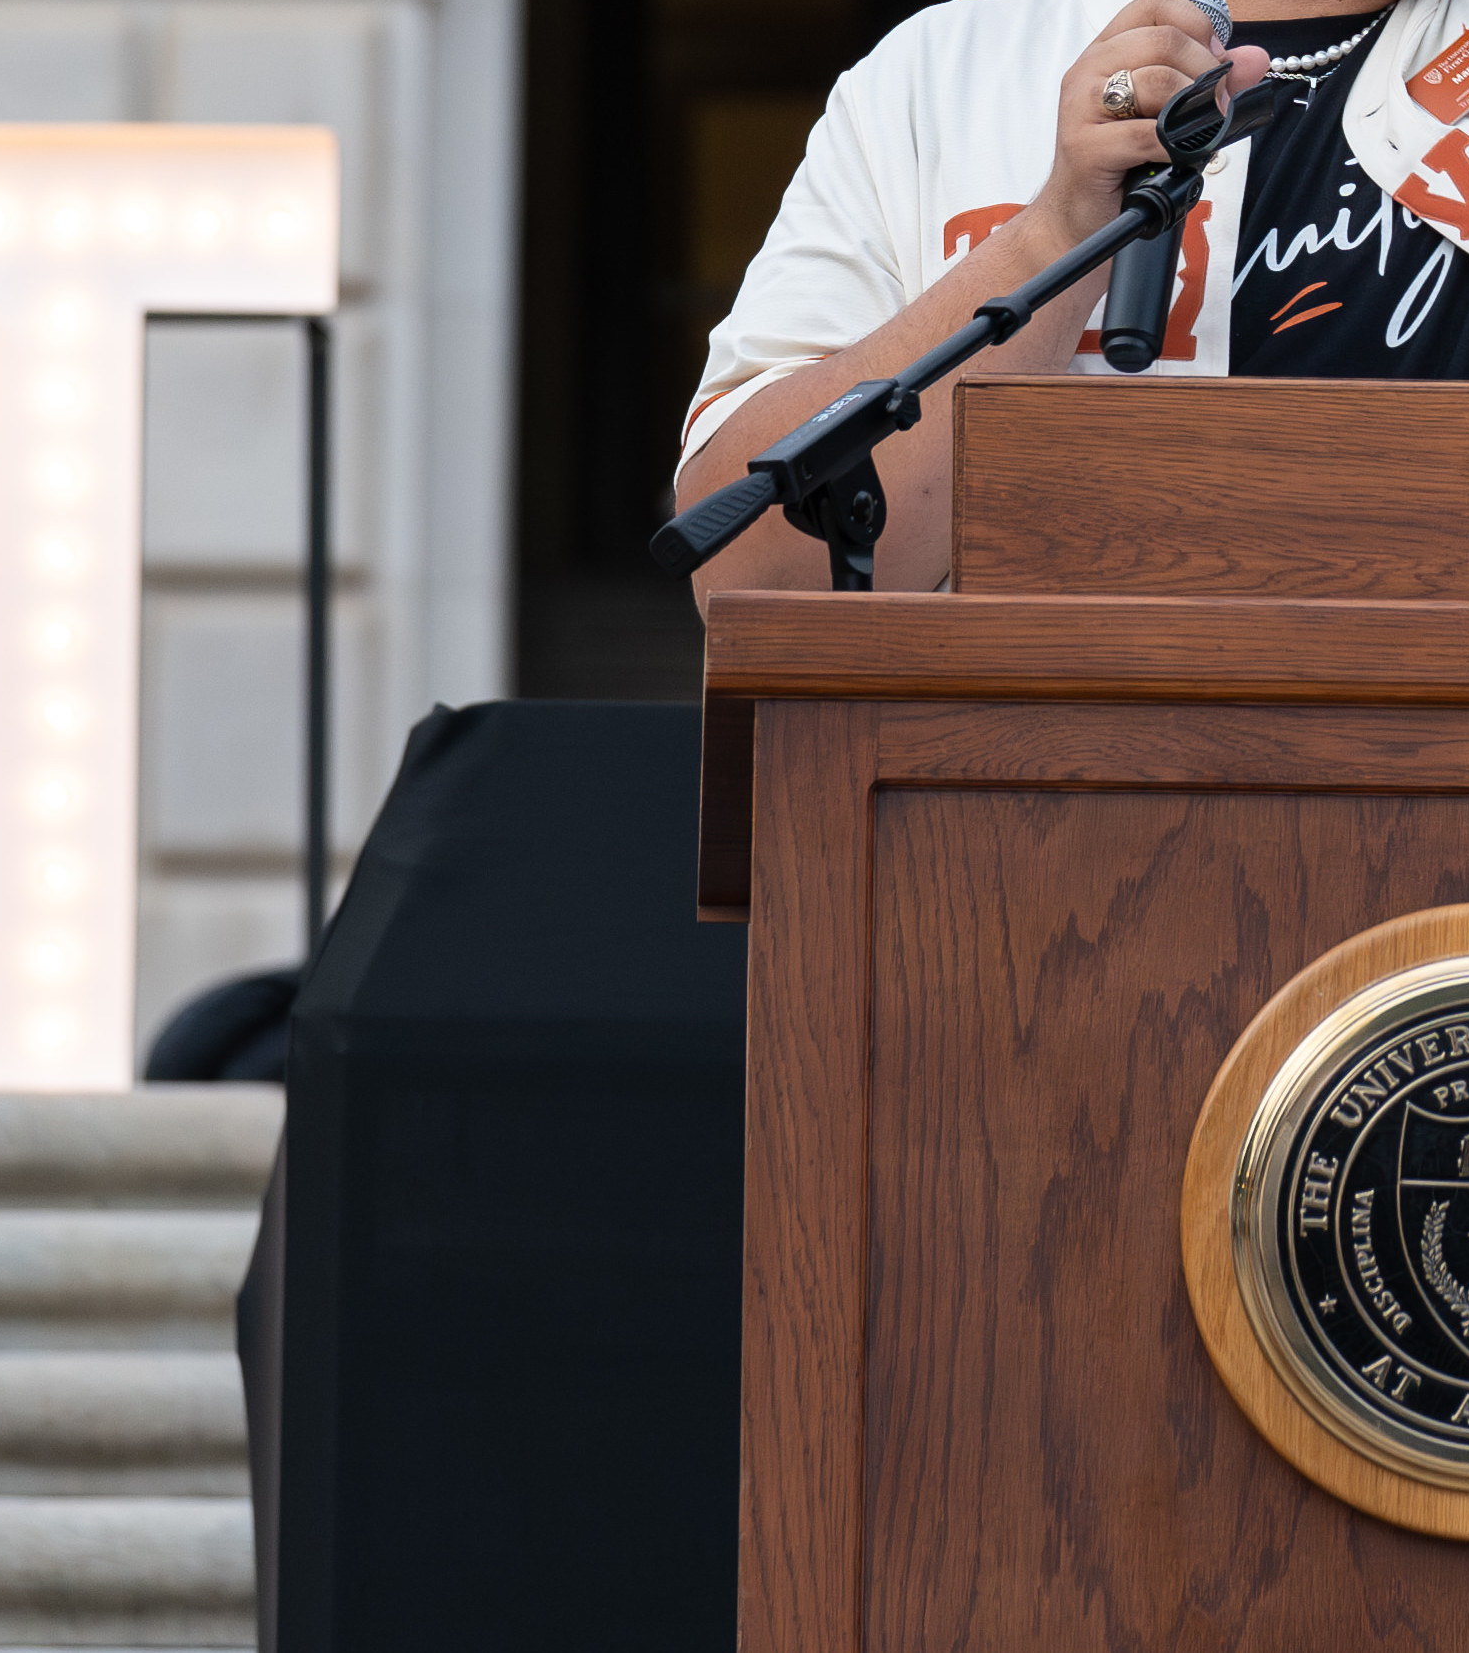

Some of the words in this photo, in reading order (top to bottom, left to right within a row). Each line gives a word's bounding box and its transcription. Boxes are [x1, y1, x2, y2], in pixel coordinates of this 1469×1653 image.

[1299, 1151, 1339, 1237] THE
[1352, 1188, 1412, 1335] DISCIPLINA
[1362, 1355, 1422, 1400] AT
